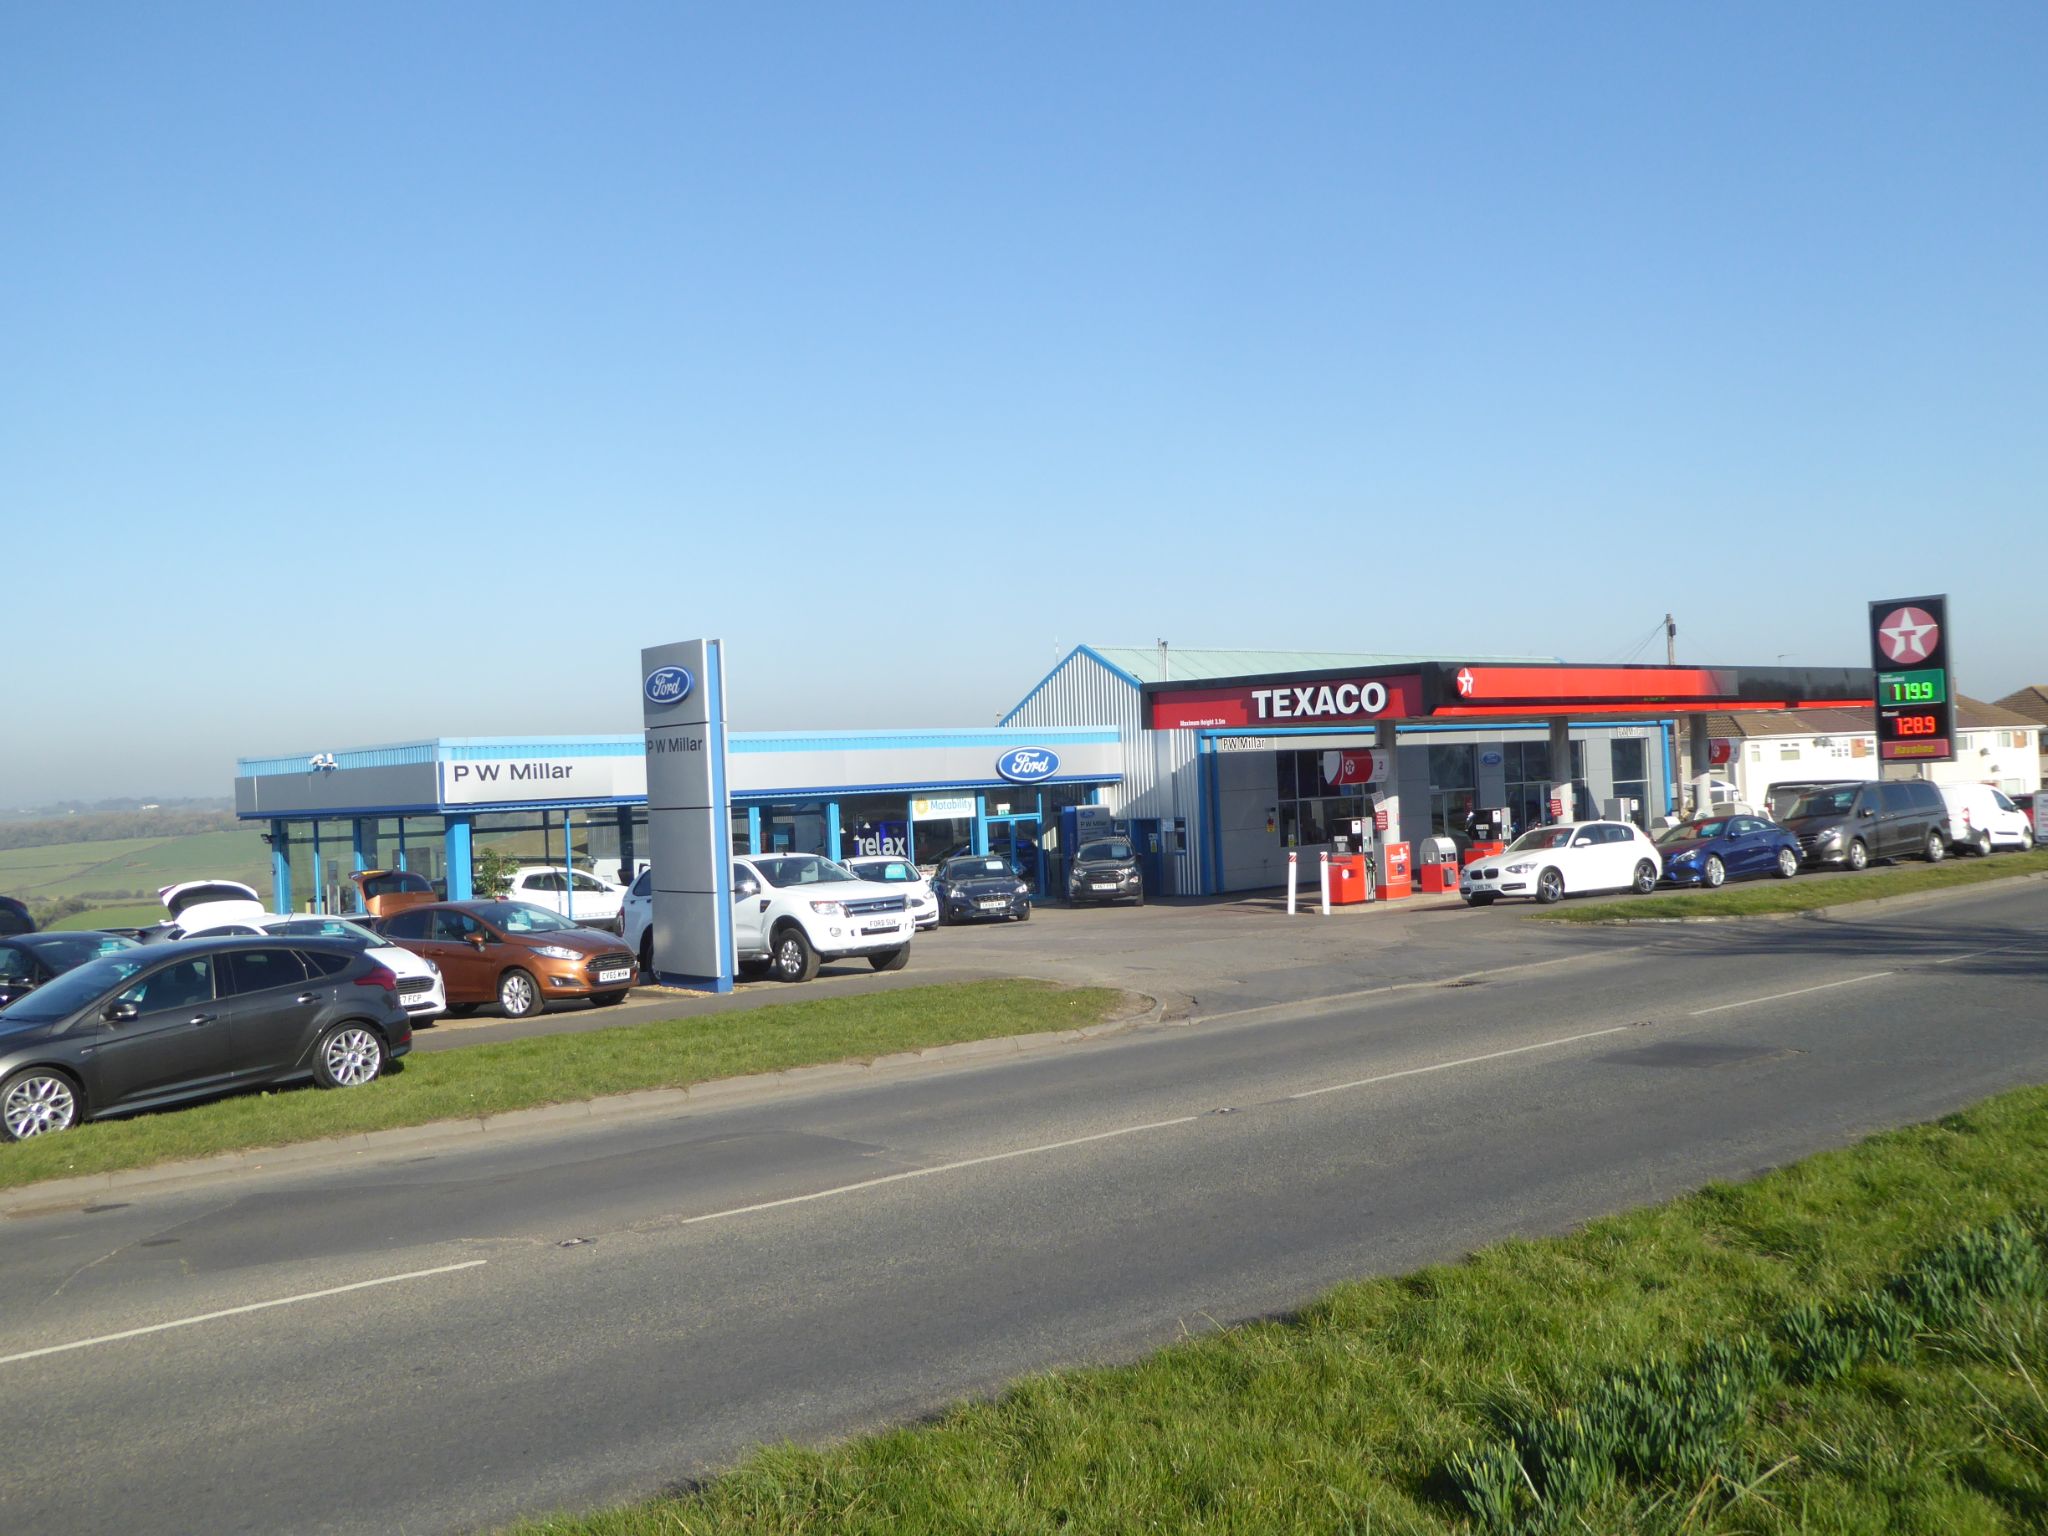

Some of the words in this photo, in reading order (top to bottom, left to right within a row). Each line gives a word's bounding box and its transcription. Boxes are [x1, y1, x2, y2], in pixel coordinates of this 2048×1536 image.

[652, 671, 681, 697] Ford
[1252, 681, 1387, 719] TEXACO
[647, 740, 654, 754] P
[656, 739, 666, 753] W
[669, 737, 703, 752] Millar
[1239, 736, 1265, 750] Millar
[454, 764, 469, 782] P
[475, 764, 501, 782] W
[509, 762, 573, 781] Millar
[1012, 751, 1049, 774] Ford
[1378, 761, 1384, 770] 2
[930, 799, 973, 811] Motability
[858, 831, 907, 856] relax
